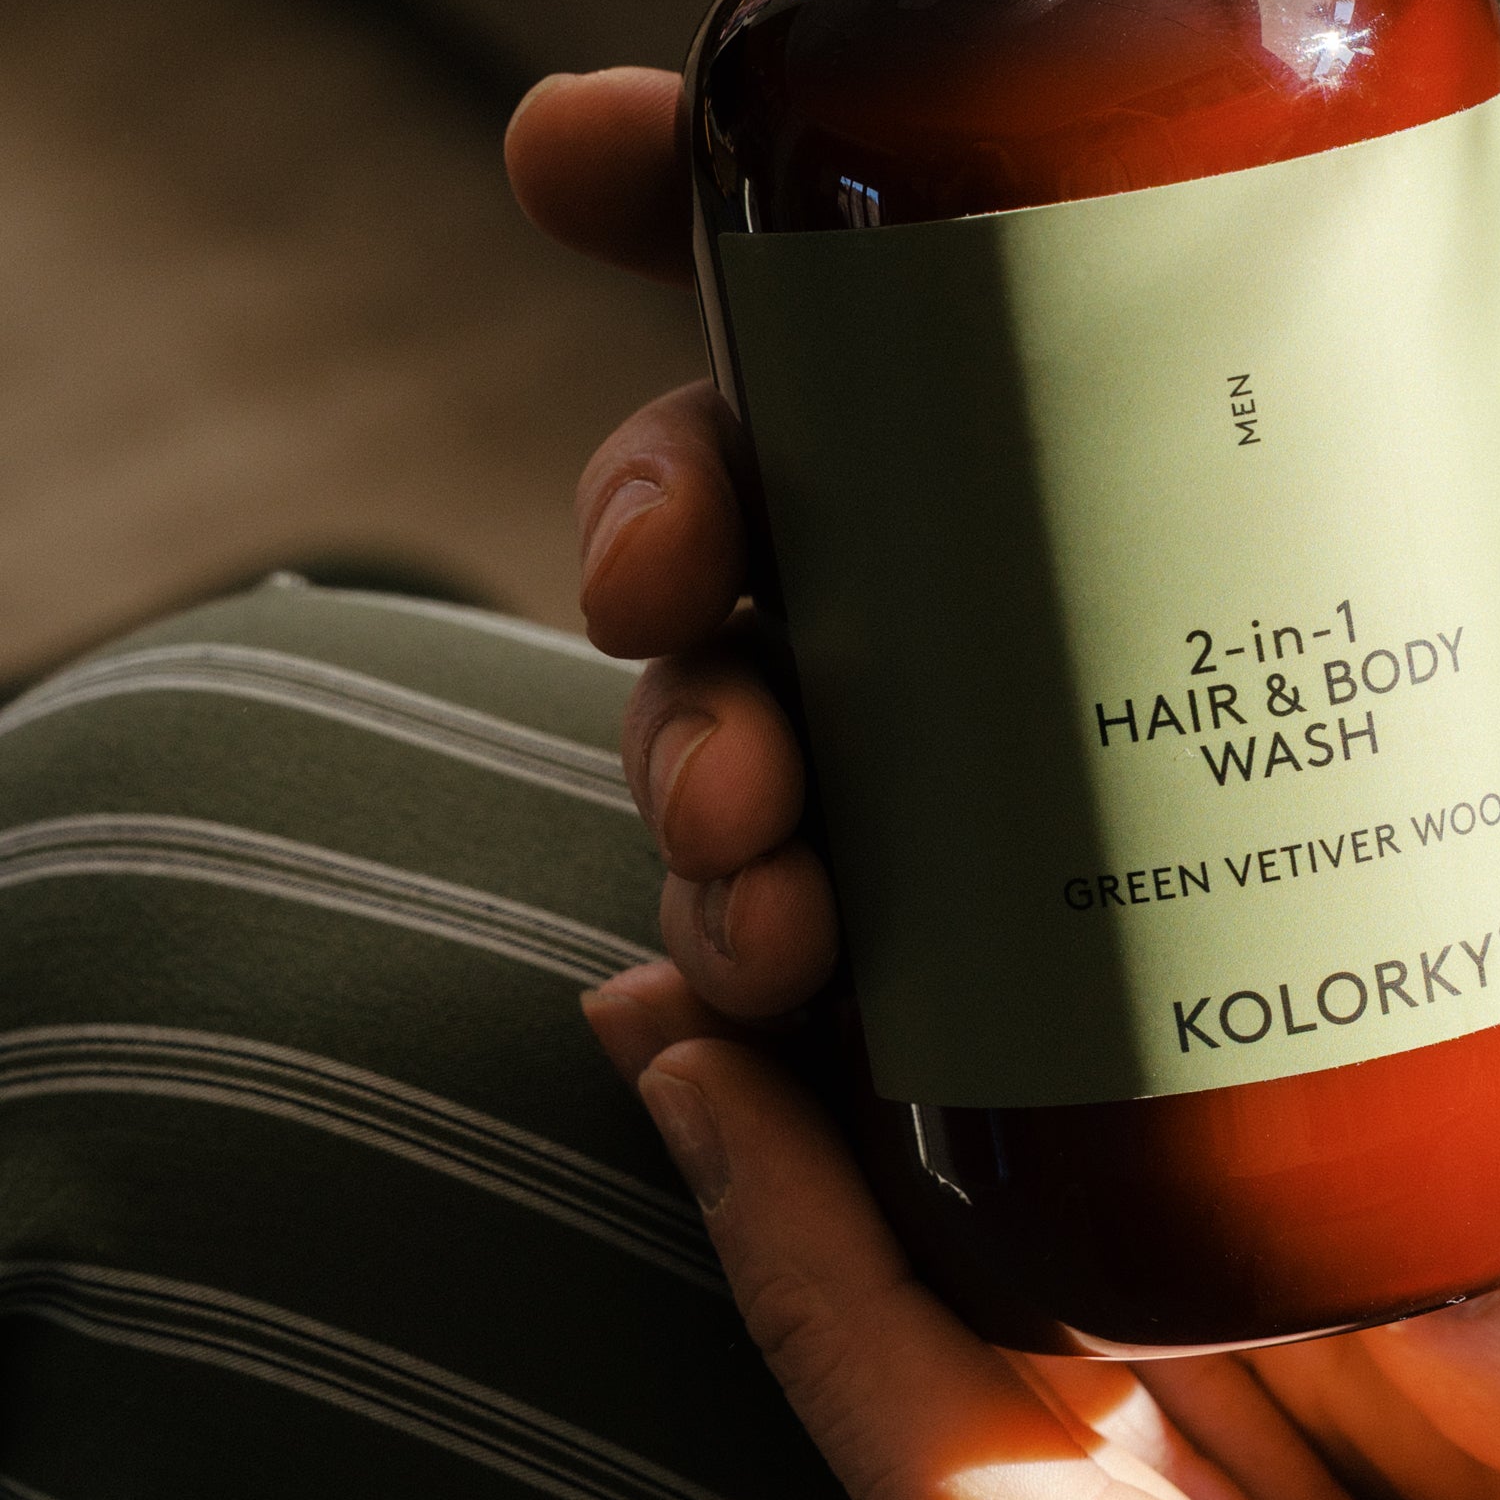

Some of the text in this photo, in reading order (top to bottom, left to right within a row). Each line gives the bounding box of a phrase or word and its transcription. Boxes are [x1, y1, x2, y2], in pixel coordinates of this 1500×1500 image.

[1227, 373, 1261, 446] MEN
[1184, 599, 1360, 675] 2-in-1
[1095, 626, 1466, 747] HAIR & BODY
[1200, 711, 1380, 787] WASH
[1063, 862, 1212, 912] GREEN
[1225, 822, 1402, 888] VETIVER
